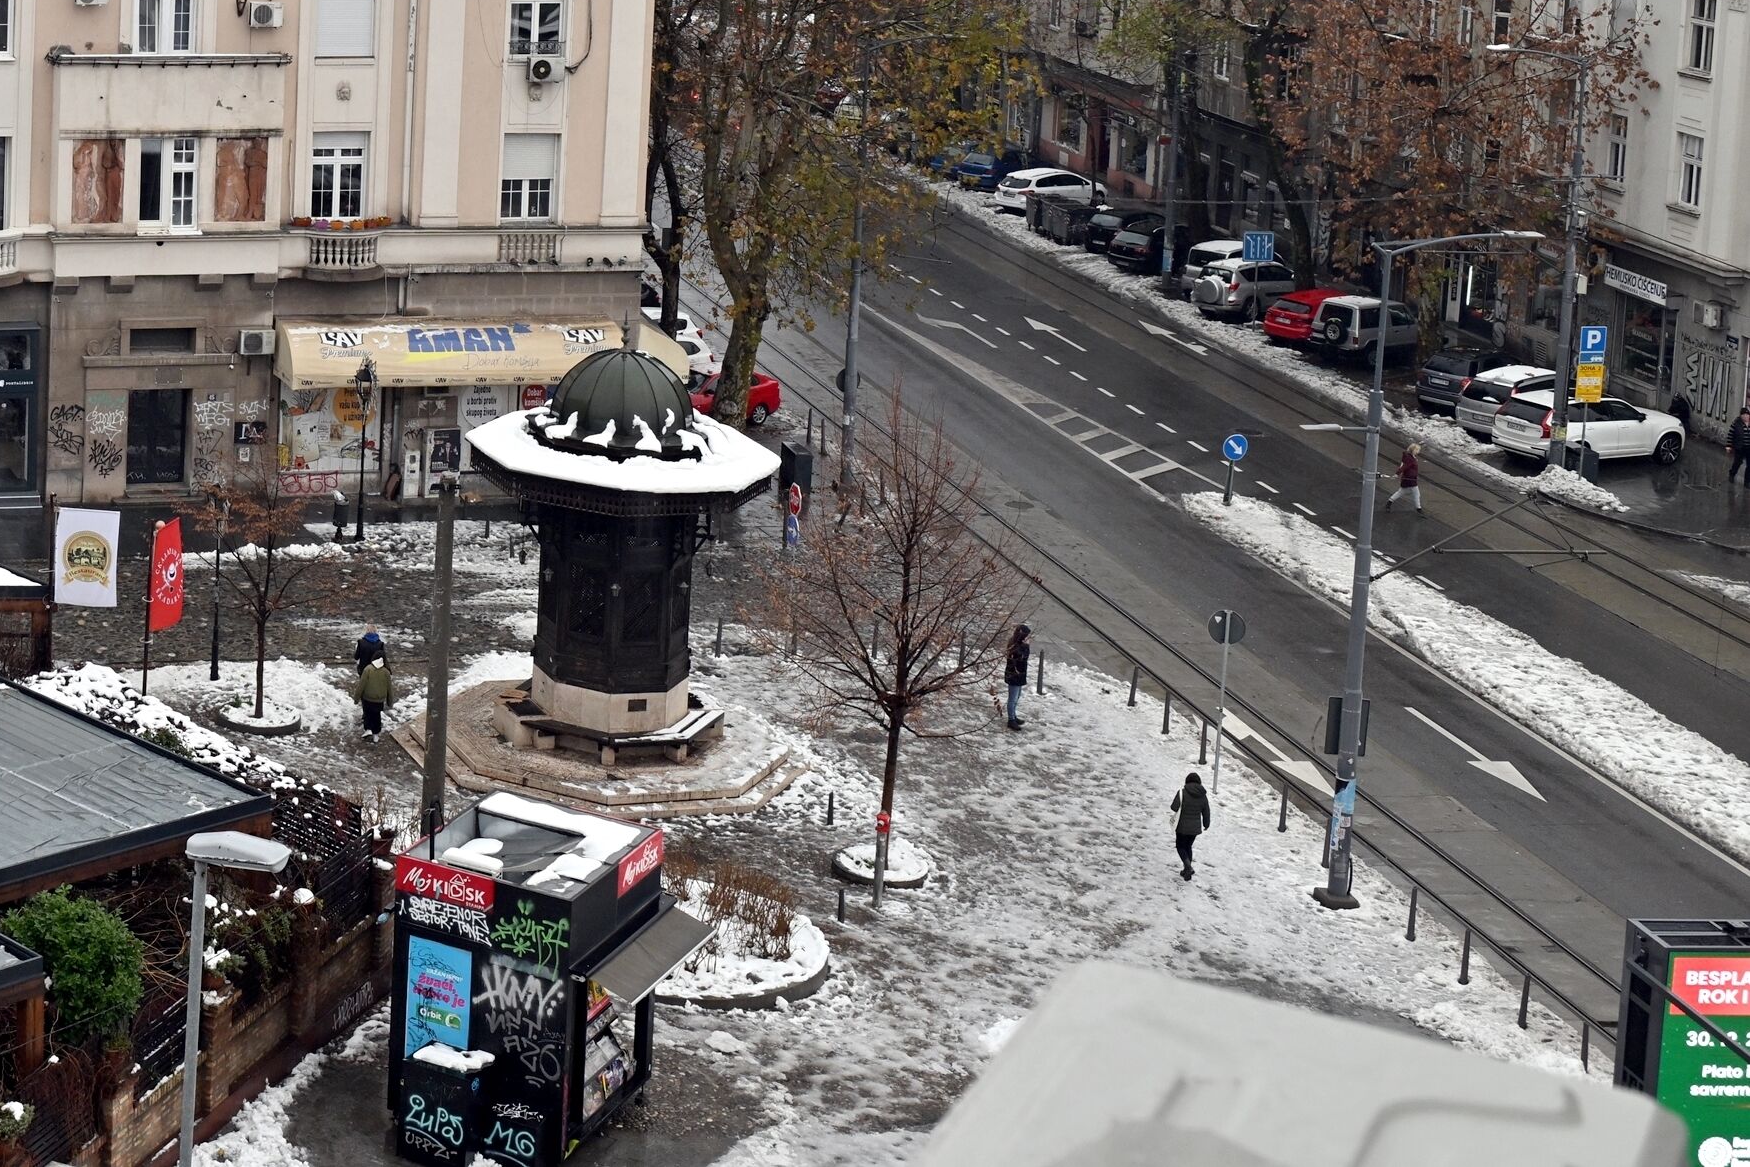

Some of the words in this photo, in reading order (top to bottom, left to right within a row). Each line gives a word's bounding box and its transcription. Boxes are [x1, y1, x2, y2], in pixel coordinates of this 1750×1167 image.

[317, 331, 363, 348] LAV
[407, 327, 516, 352] AMAN
[562, 329, 605, 344] LAV
[1586, 330, 1602, 349] P
[474, 385, 491, 394] Zajedno
[471, 397, 482, 405] borbi
[483, 396, 497, 406] protiv
[466, 408, 482, 418] skupog
[483, 407, 497, 416] života
[403, 866, 433, 892] Moj
[433, 875, 486, 905] KIOSK
[451, 991, 465, 1008] je
[1698, 989, 1738, 1004] ROK
[419, 1006, 442, 1021] Orbit
[1686, 1030, 1715, 1047] 30.
[1701, 1064, 1744, 1079] Plato
